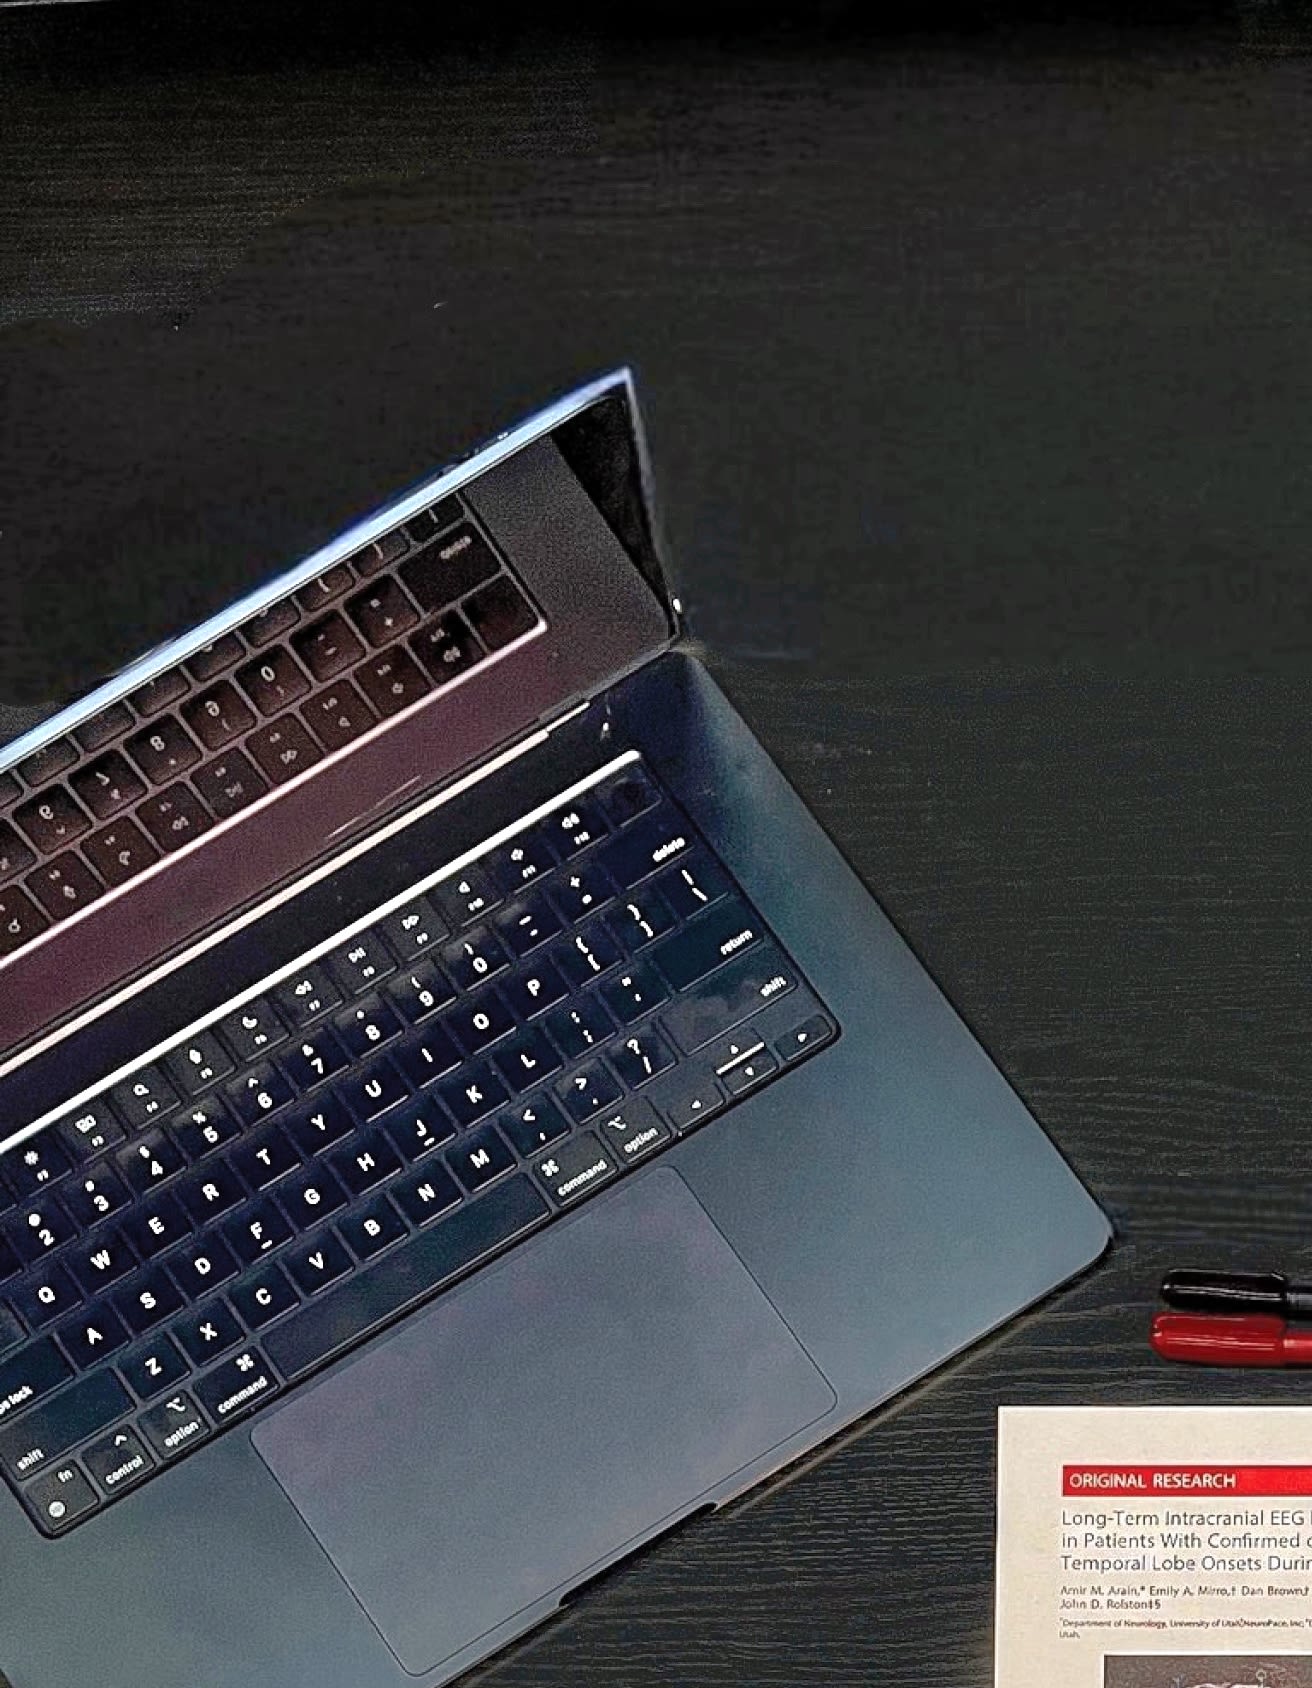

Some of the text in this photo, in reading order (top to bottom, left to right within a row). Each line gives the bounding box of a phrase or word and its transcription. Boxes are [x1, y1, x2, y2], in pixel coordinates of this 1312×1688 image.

[1069, 1473, 1236, 1488] ORIGINAL RESEARCH
[1063, 1510, 1159, 1529] Long-Term
[1165, 1510, 1263, 1525] Intracranial
[1271, 1510, 1304, 1525] EEG
[1063, 1533, 1077, 1548] in
[1085, 1533, 1155, 1548] Patients
[1160, 1533, 1201, 1548] With
[1208, 1532, 1300, 1548] Confirmed
[1061, 1555, 1145, 1574] Temporal
[1152, 1555, 1195, 1571] Lobe
[1201, 1556, 1264, 1571] Onsets
